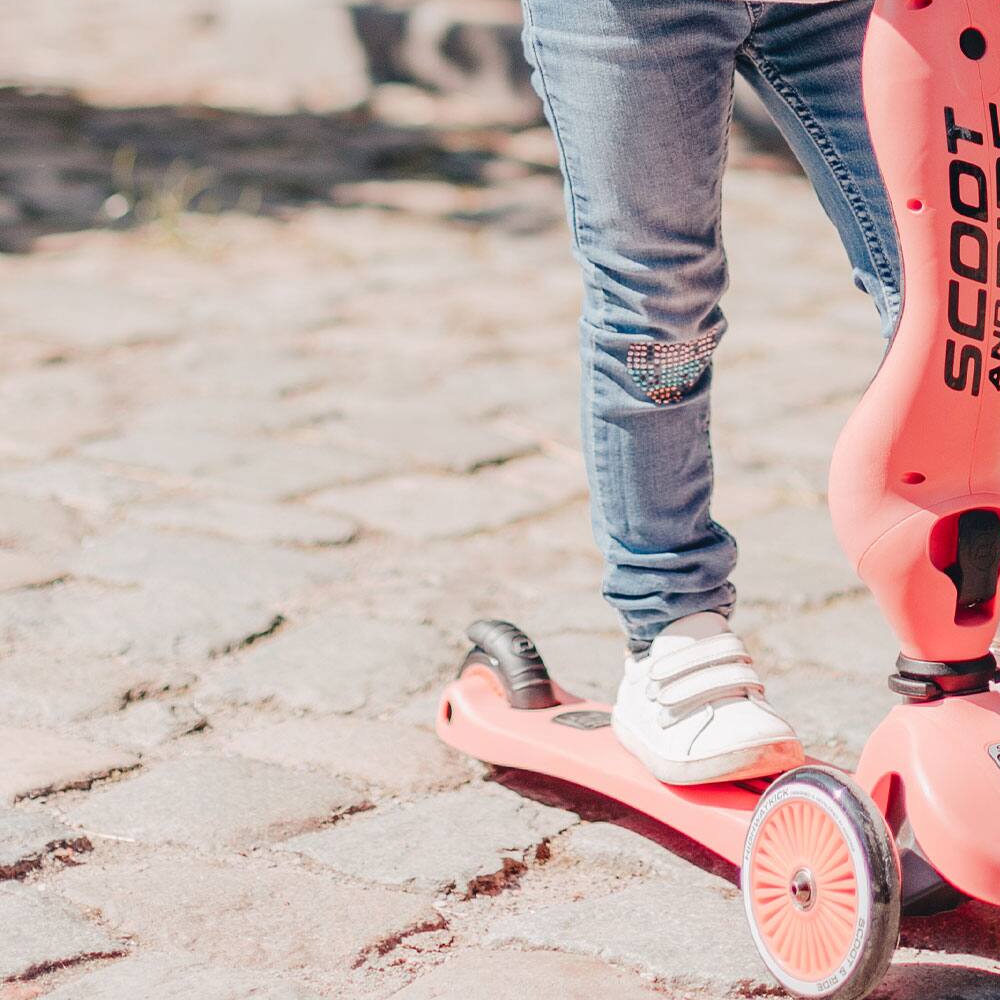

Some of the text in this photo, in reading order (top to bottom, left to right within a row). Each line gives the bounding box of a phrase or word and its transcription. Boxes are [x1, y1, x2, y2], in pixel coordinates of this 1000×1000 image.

[943, 106, 989, 397] SCOOT
[847, 918, 866, 968] SCOOT
[816, 975, 839, 992] RIDE
